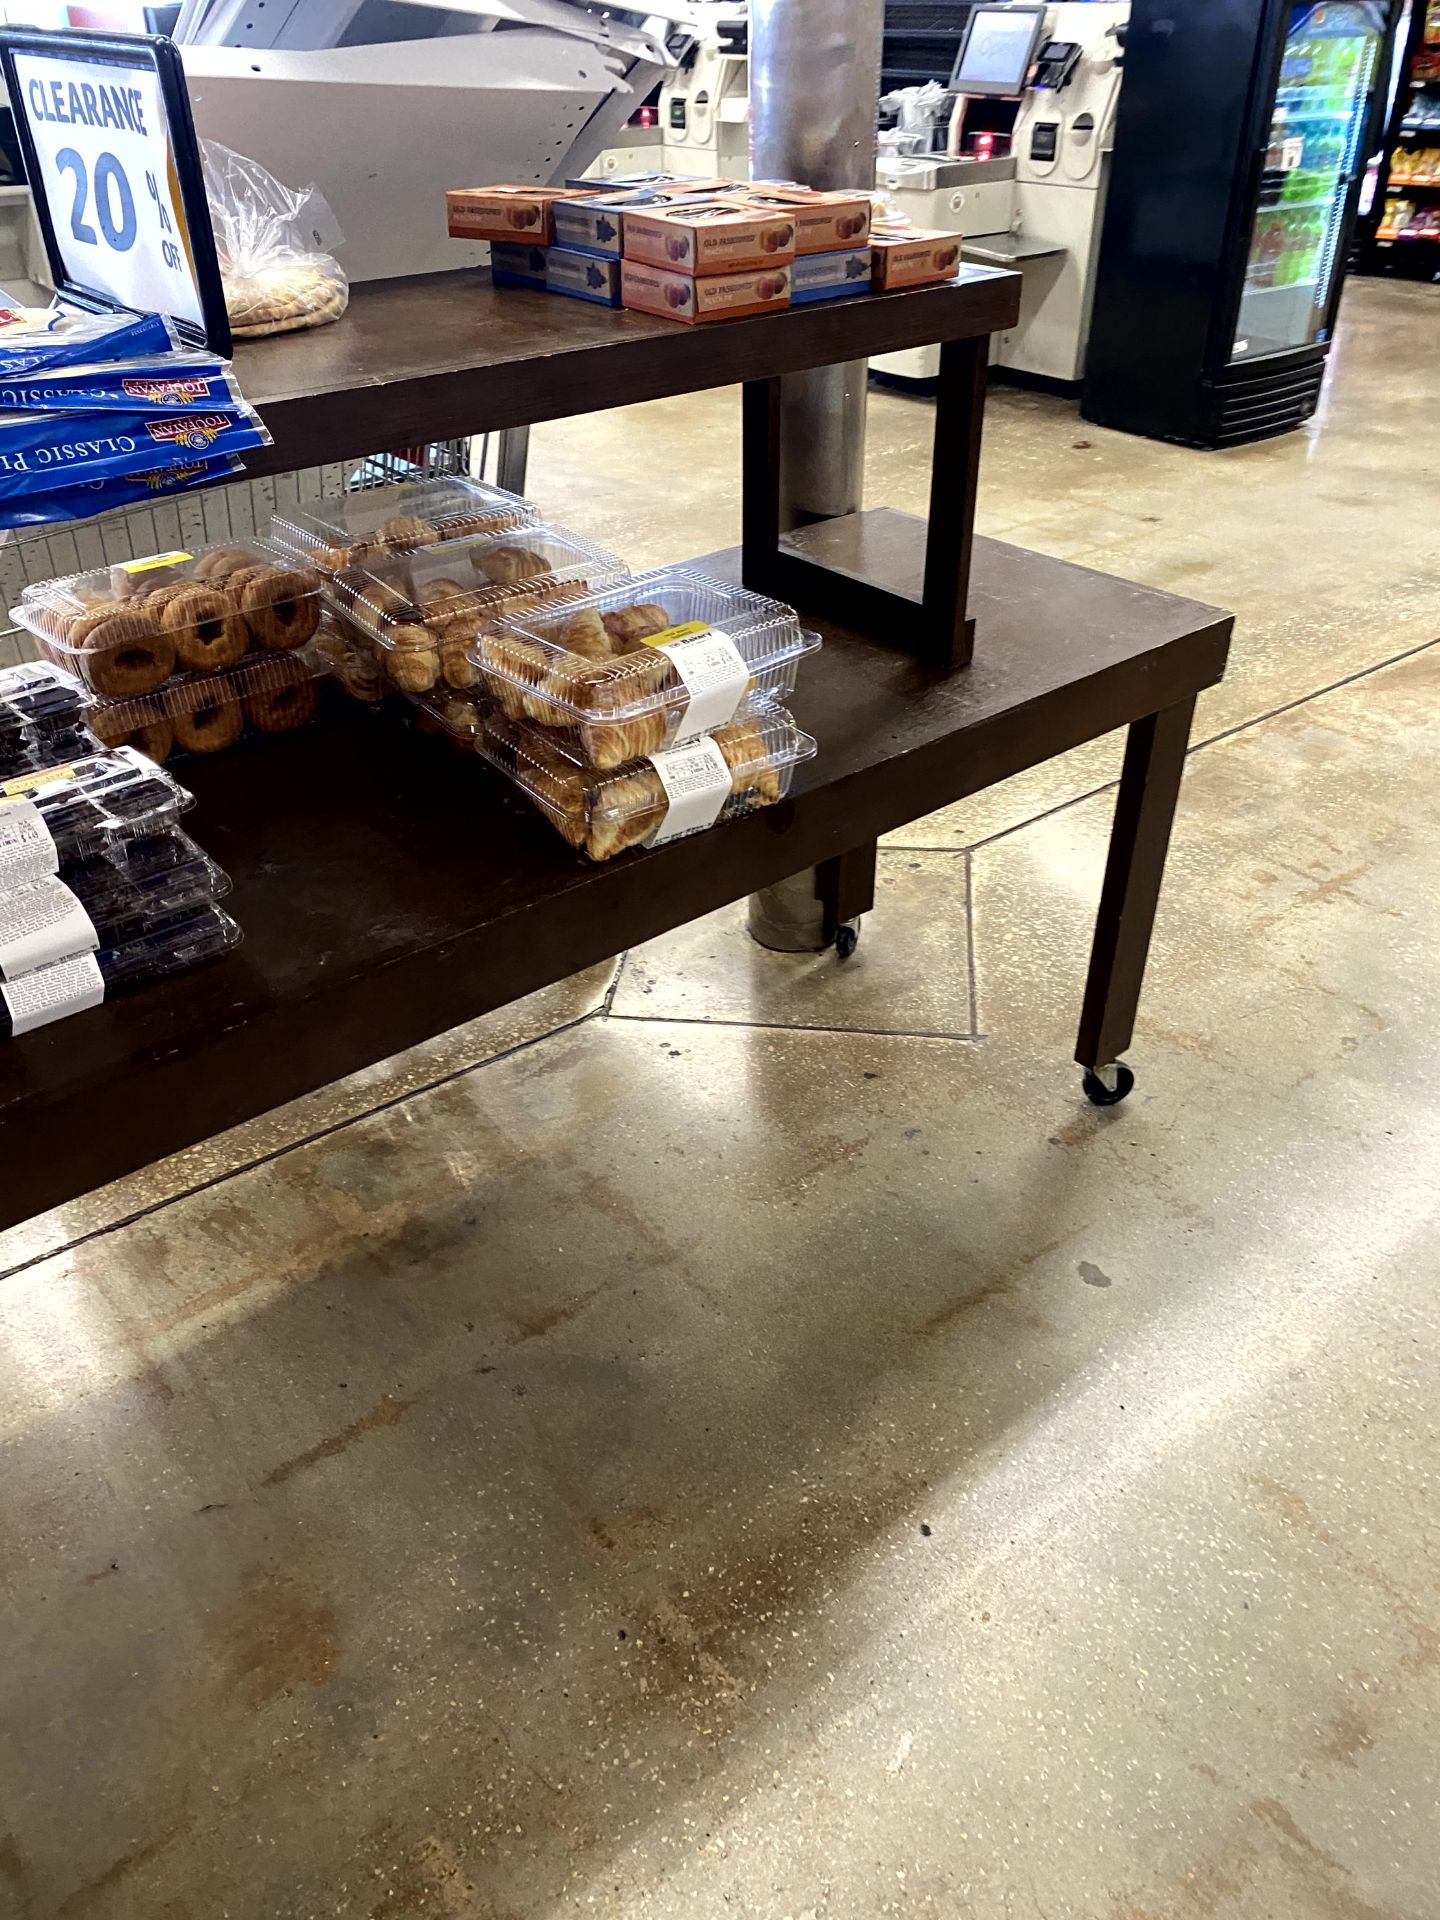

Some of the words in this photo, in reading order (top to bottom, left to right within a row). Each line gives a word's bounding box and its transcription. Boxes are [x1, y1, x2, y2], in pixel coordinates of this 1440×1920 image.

[28, 78, 148, 137] CLEARANCE
[55, 147, 138, 252] 20
[161, 239, 183, 272] OFF
[128, 380, 206, 394] TOUFAYAN
[152, 415, 227, 438] TOUFAYAN
[0, 452, 32, 471] PI
[35, 436, 136, 464] CLASSIC
